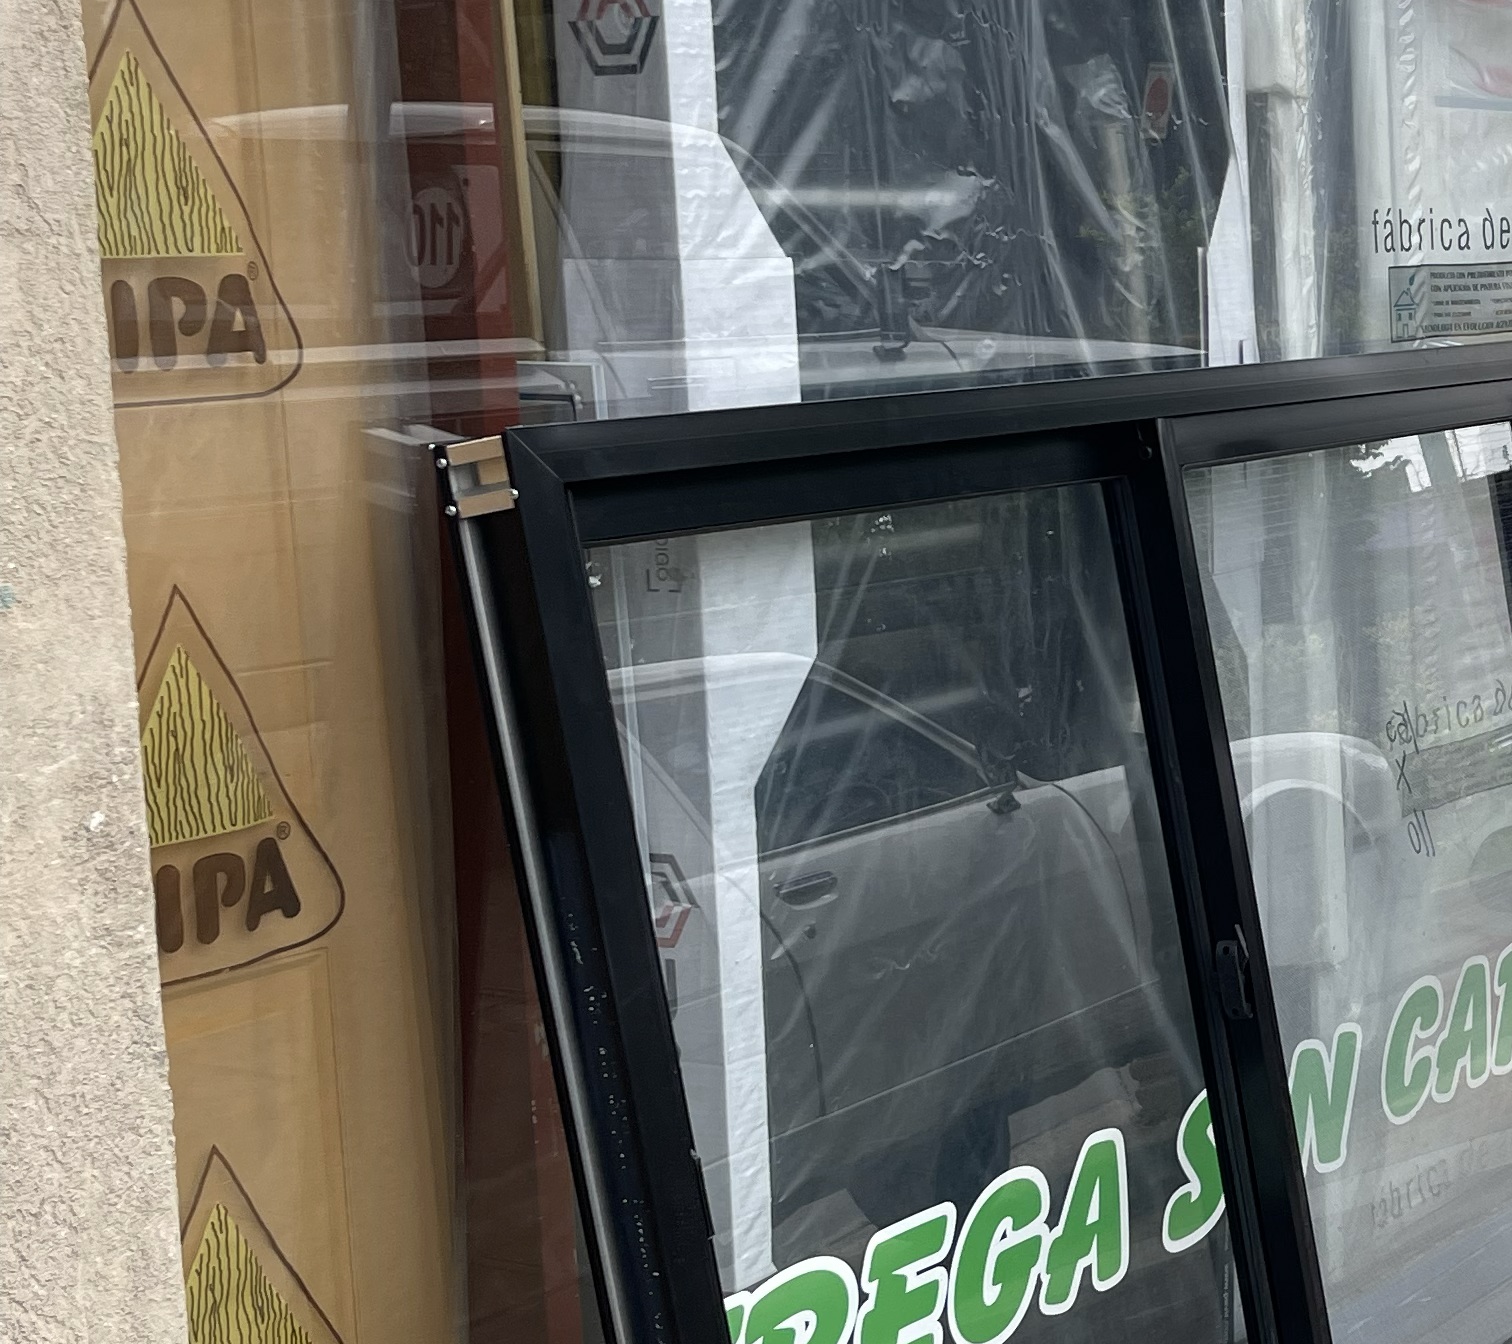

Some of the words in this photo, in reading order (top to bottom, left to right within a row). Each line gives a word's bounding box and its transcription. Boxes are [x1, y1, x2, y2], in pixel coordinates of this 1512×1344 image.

[1372, 207, 1471, 254] fábrica
[1482, 207, 1511, 251] de
[1162, 1022, 1362, 1253] SN
